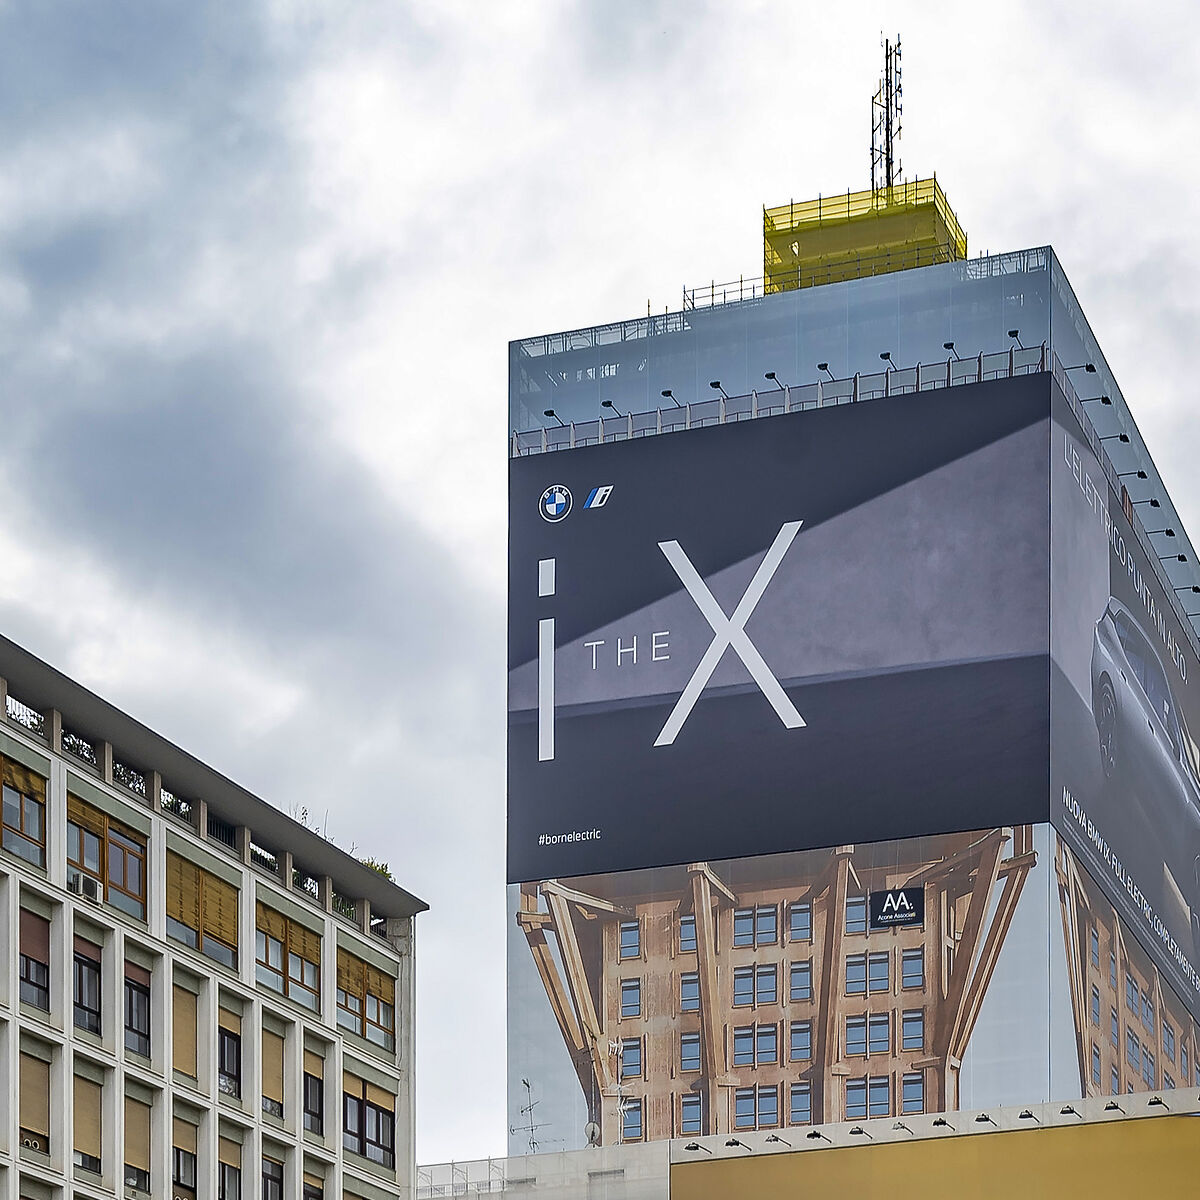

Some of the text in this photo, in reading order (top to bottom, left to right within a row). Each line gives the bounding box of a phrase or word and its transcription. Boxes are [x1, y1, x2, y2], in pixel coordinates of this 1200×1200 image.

[1063, 433, 1189, 684] L'ELETTRICO PUNTA IN ALTO.
[584, 631, 669, 670] THE
[538, 828, 601, 845] #bornelectric
[1062, 786, 1087, 833] NUOVA
[1087, 819, 1103, 853] BMW
[1112, 853, 1126, 888] FULL
[1154, 914, 1196, 985] COMPLETAMENTE
